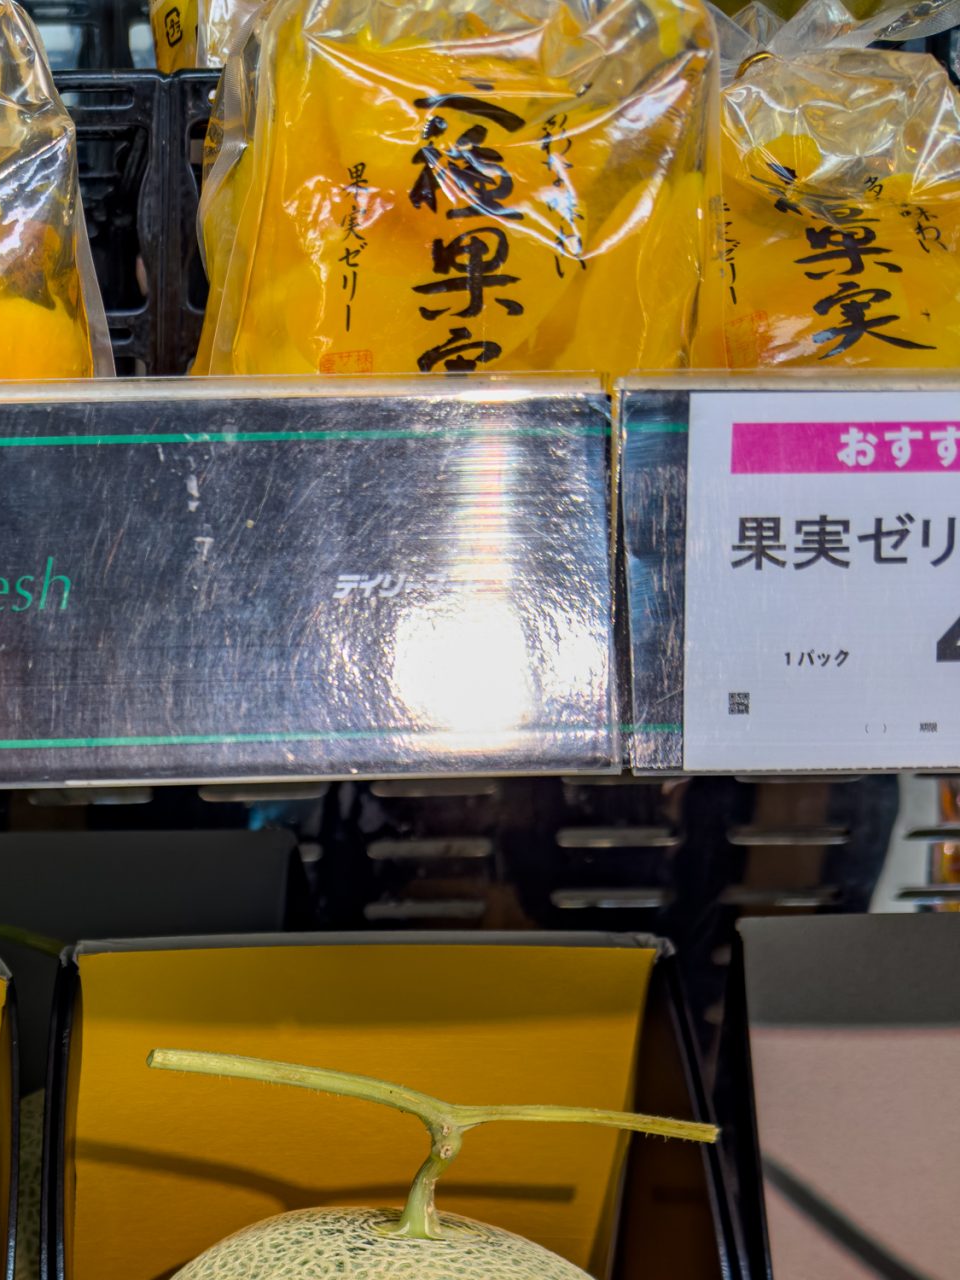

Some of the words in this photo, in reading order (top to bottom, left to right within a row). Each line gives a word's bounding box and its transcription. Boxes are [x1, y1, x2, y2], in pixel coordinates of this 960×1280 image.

[338, 162, 369, 332] 果実ゼリー
